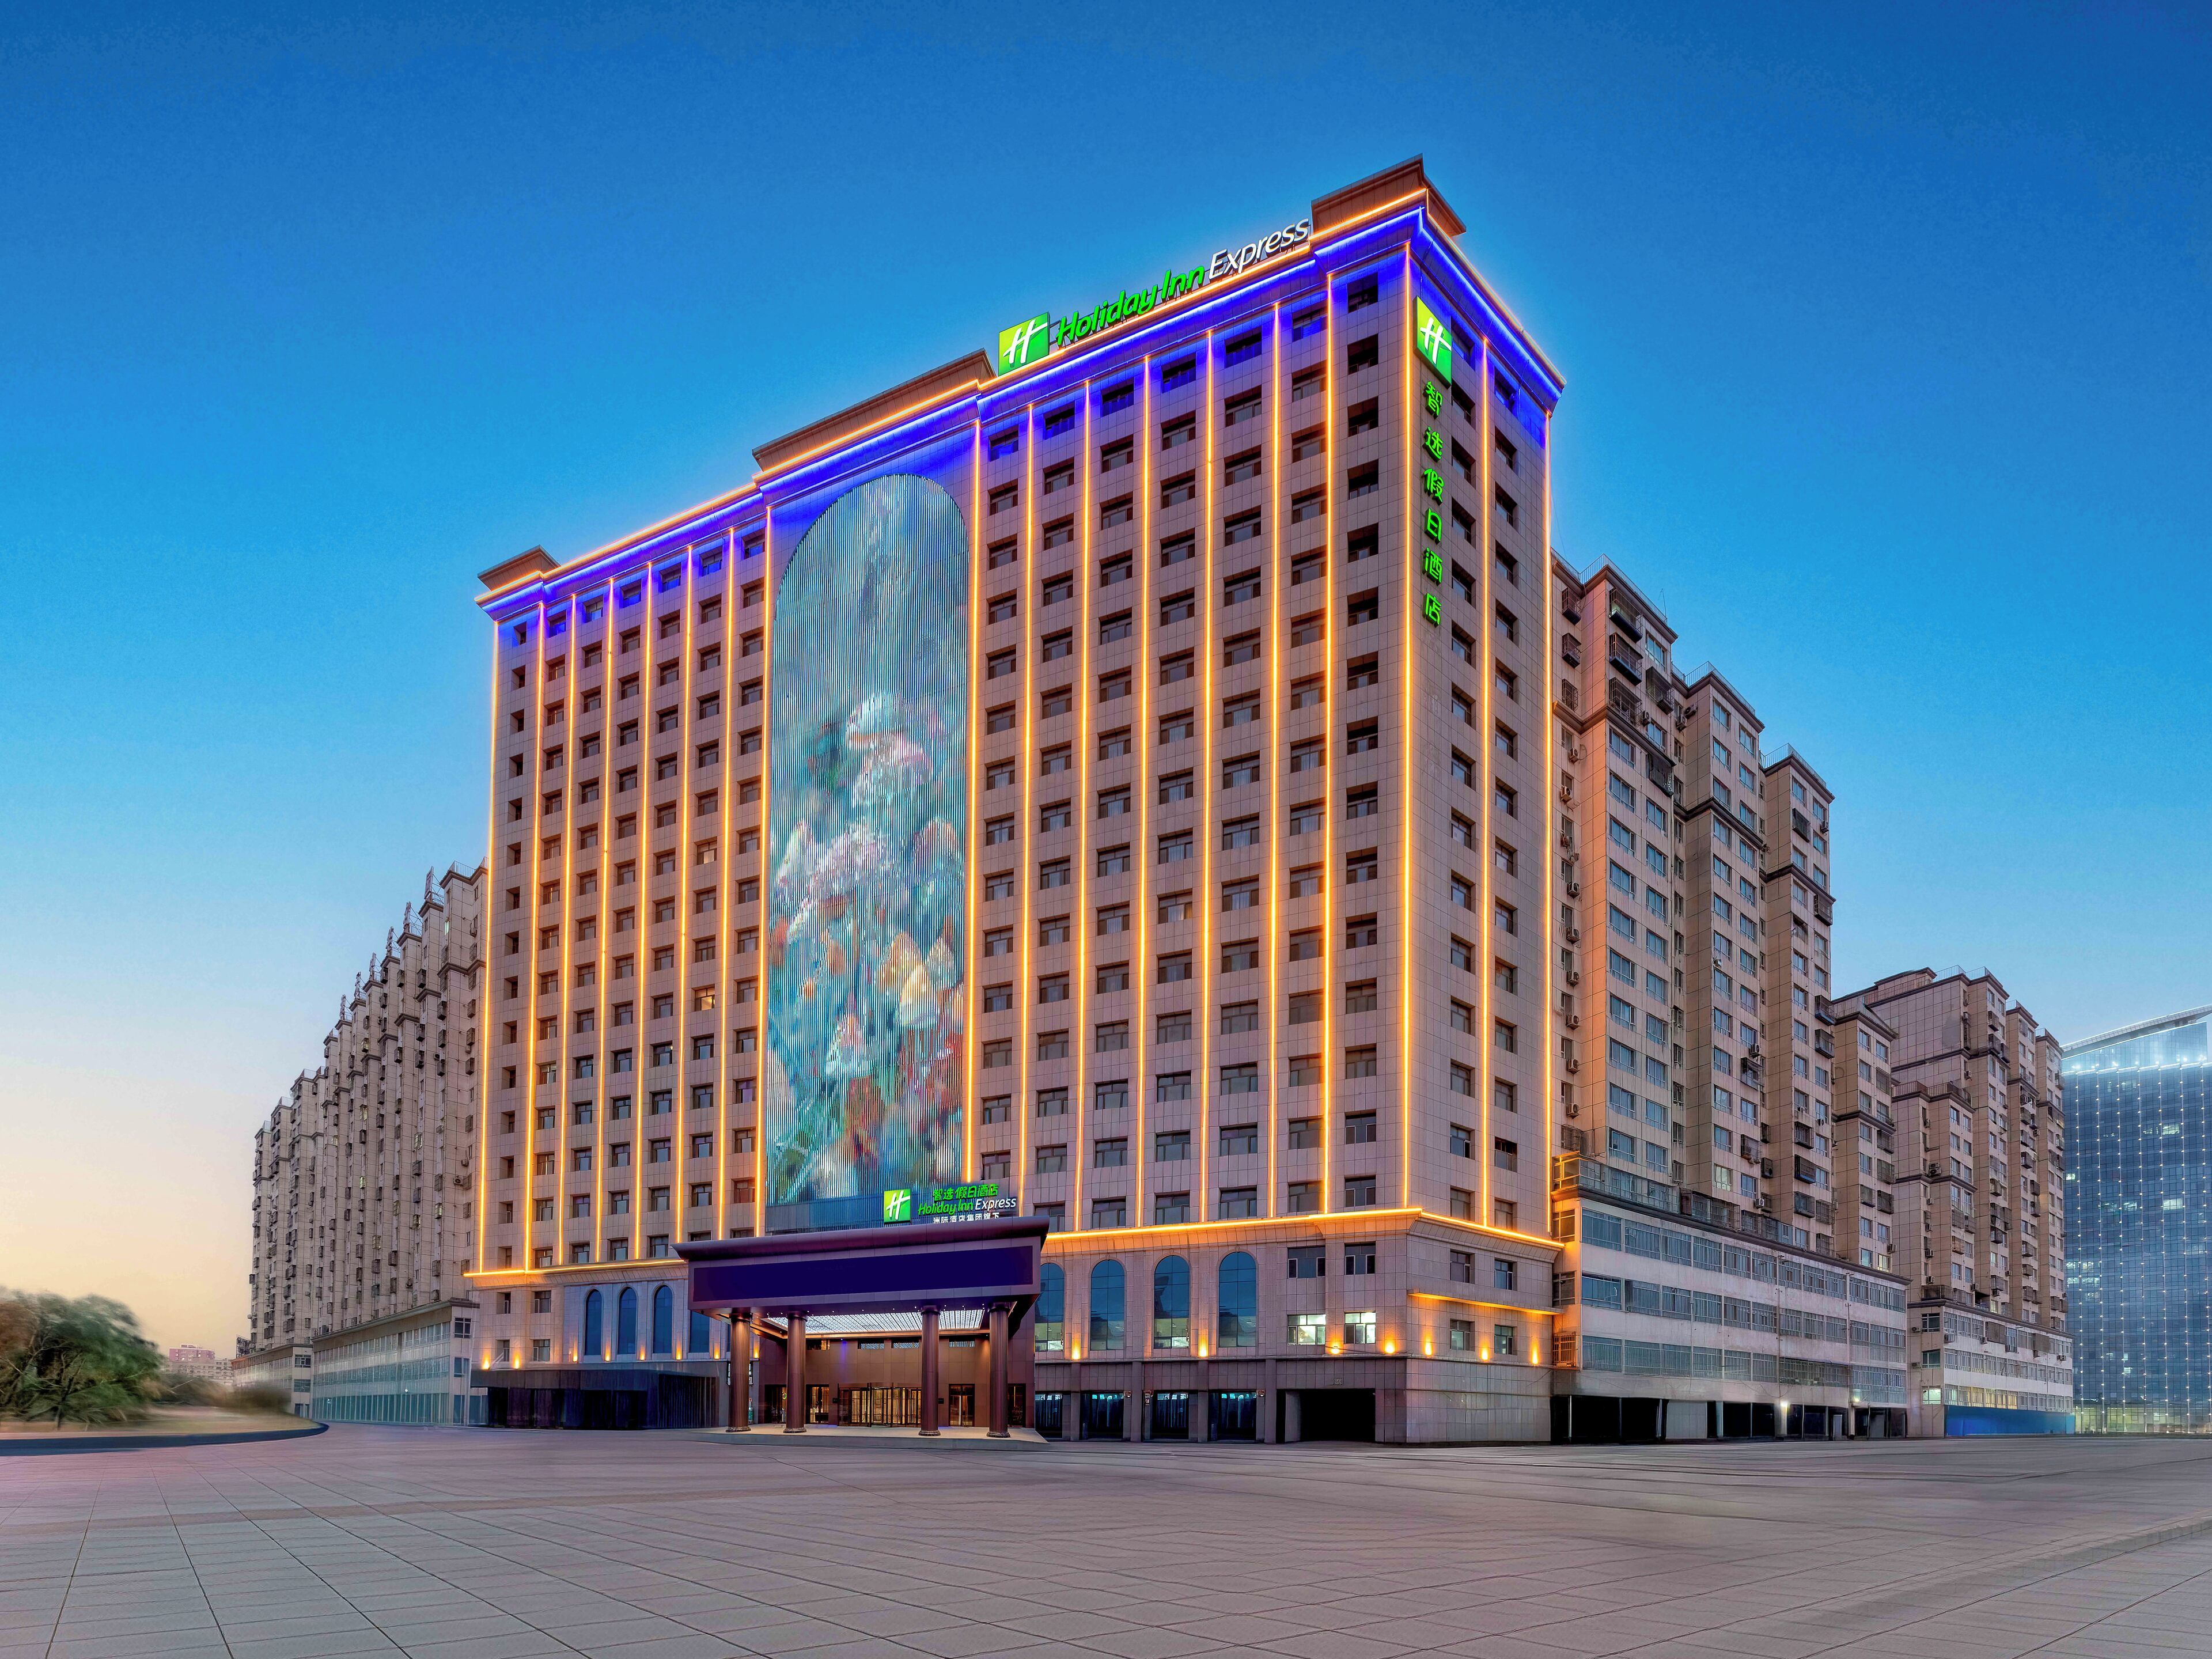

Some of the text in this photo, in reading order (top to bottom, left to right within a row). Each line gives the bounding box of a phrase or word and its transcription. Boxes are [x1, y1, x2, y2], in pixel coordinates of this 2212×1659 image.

[1056, 218, 1309, 345] Holiday Inn Express
[1424, 381, 1444, 626] 智选假日酒店
[933, 1184, 998, 1200] 智选假日酒店
[918, 1197, 1017, 1216] Holiday Inn Express
[933, 1212, 999, 1224] 洲际酒店集团旗下
